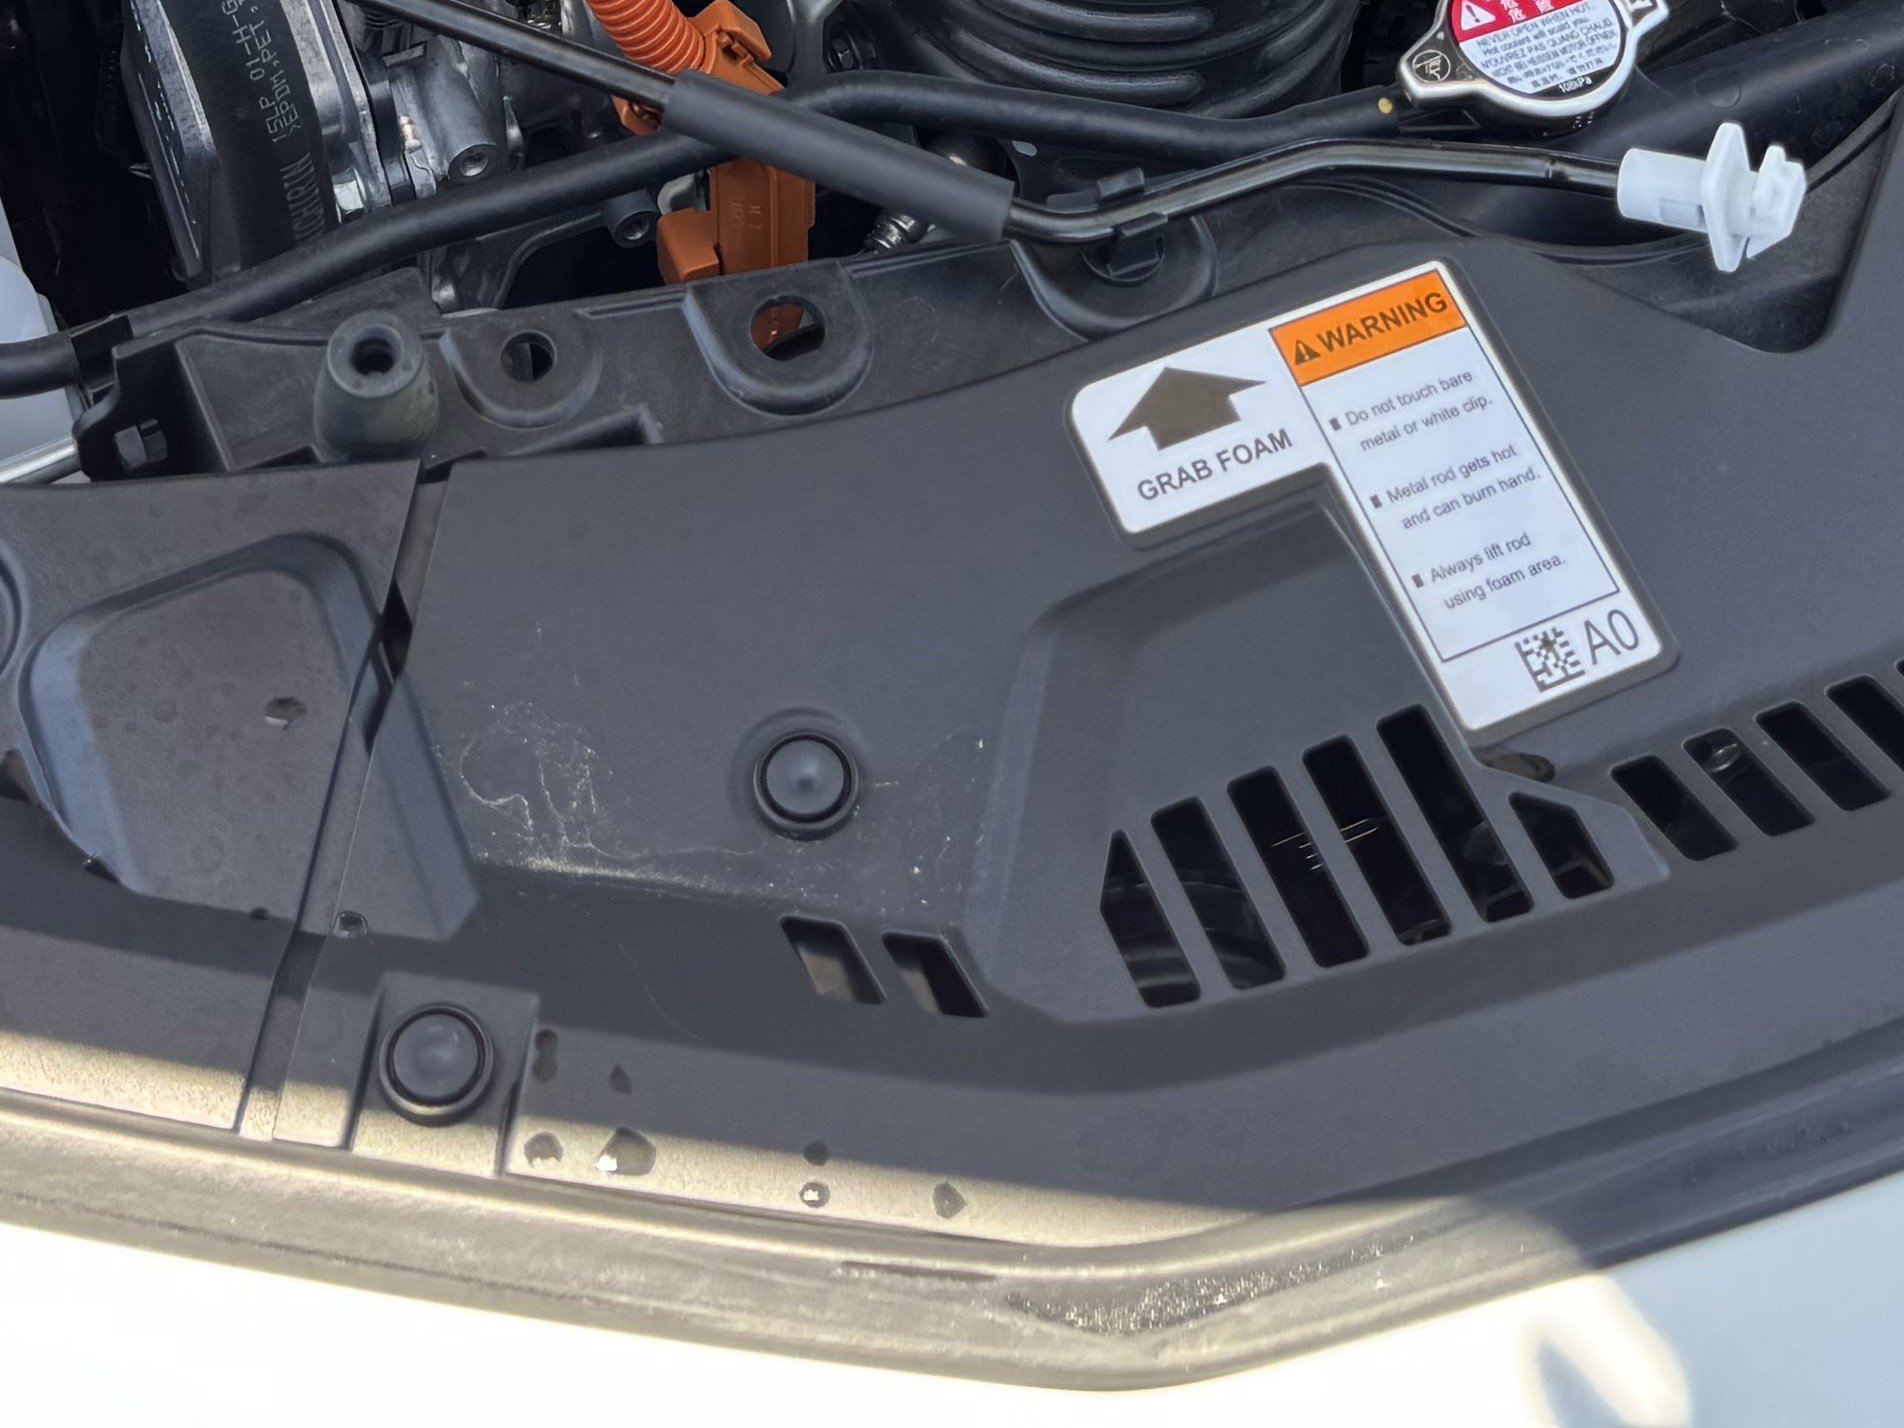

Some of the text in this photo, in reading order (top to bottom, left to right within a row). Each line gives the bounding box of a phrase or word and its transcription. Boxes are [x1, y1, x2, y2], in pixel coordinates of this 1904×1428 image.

[1316, 291, 1448, 354] WARNING
[1345, 369, 1474, 428] Do not touch bare
[1359, 395, 1493, 452] metal or white clip.
[1136, 427, 1294, 502] GRAB FOAM
[1386, 443, 1517, 504] Metal rod gets hot
[1400, 466, 1541, 531] and can burn hand.
[1429, 531, 1532, 585] Always lift rod
[1443, 553, 1567, 612] using foam area.
[1584, 607, 1641, 665] A0
